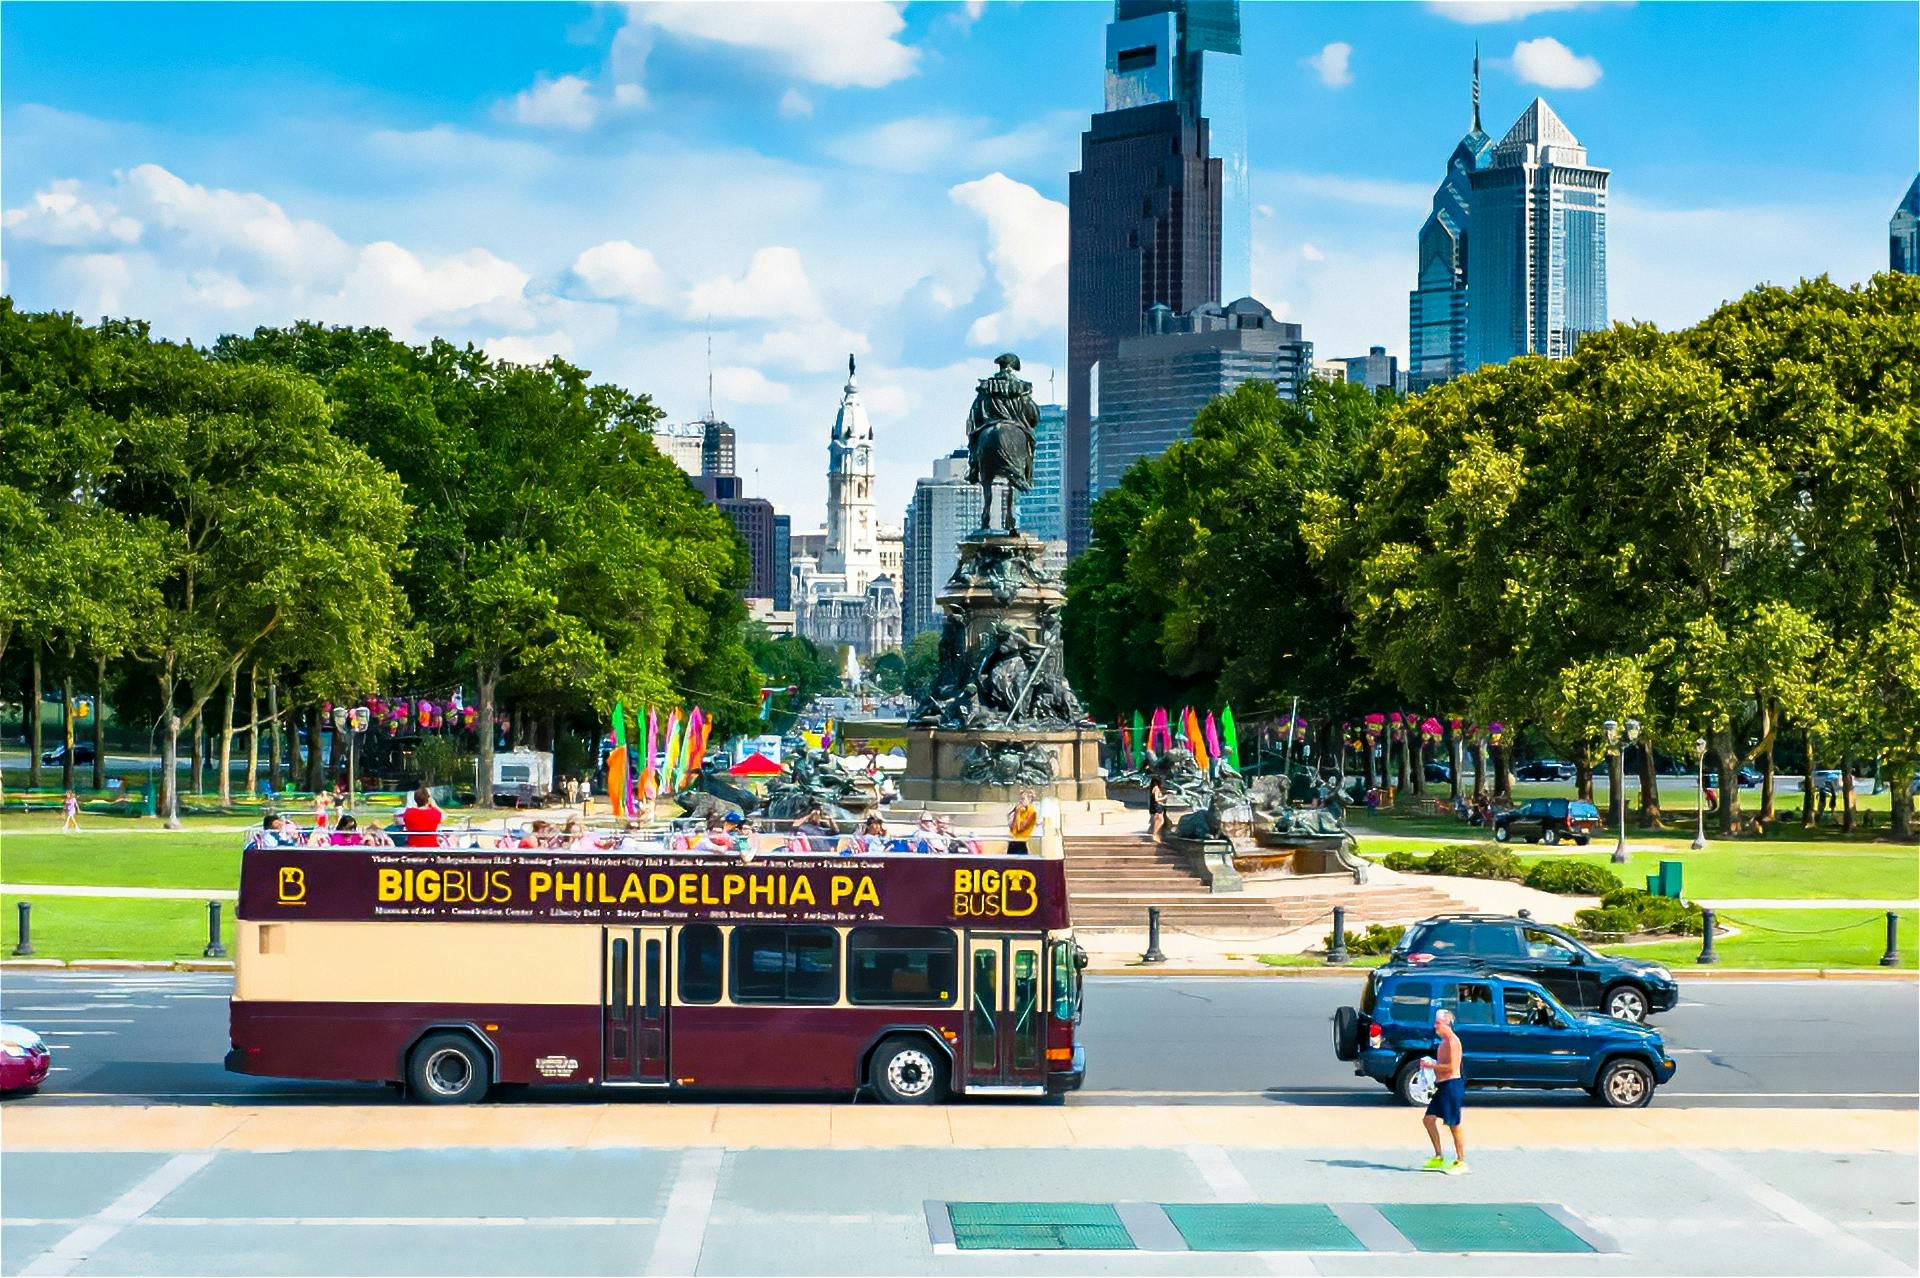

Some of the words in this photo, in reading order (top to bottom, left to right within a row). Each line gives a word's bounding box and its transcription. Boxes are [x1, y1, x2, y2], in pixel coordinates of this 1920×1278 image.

[378, 869, 513, 902] BIGBUS
[529, 872, 816, 905] PHILADELPHIA
[831, 875, 880, 906] PA
[954, 869, 1000, 893] BIG
[954, 893, 1000, 916] BUS
